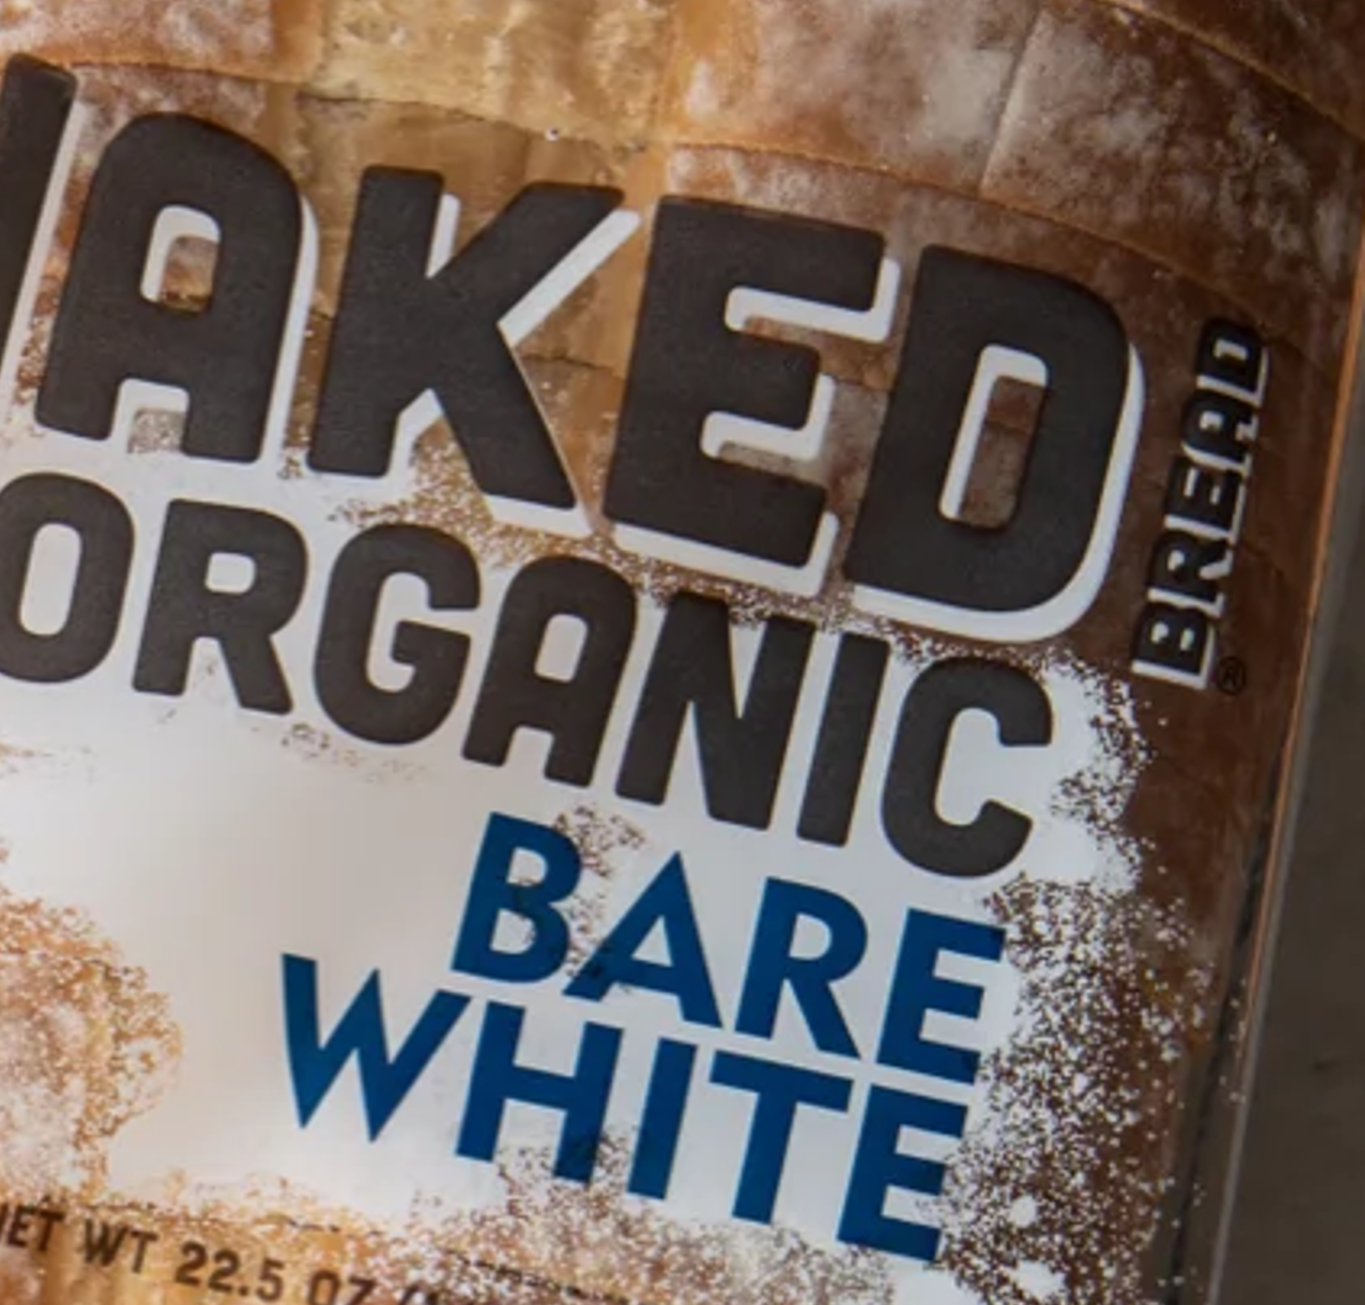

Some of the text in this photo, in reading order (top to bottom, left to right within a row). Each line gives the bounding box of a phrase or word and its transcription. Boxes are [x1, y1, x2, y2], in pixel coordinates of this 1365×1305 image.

[1132, 316, 1268, 688] BREAD
[451, 811, 1007, 1085] BARE
[281, 952, 969, 1264] WHITE
[82, 1219, 158, 1274] WT
[175, 1241, 284, 1302] 22.5
